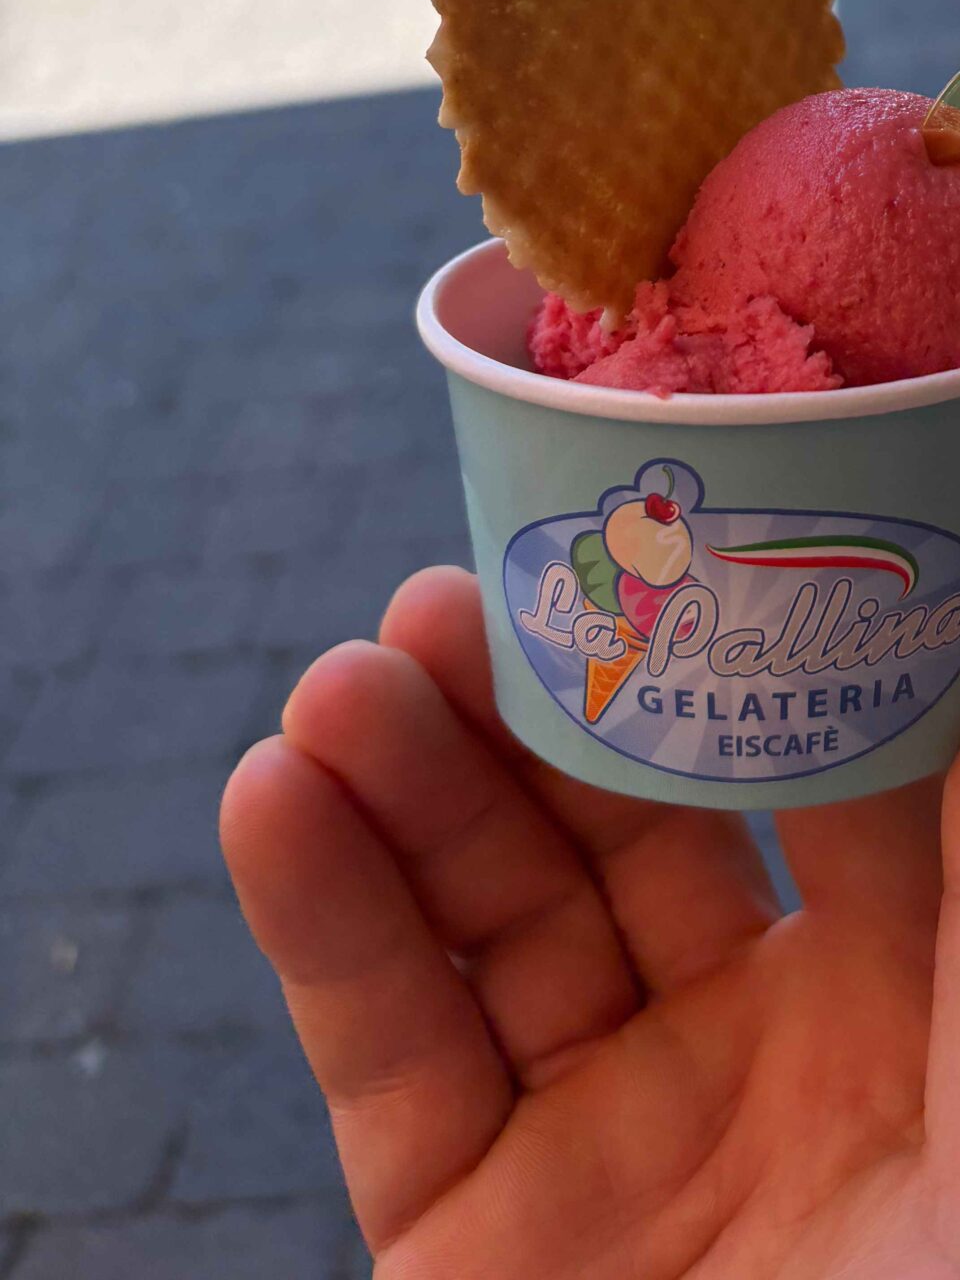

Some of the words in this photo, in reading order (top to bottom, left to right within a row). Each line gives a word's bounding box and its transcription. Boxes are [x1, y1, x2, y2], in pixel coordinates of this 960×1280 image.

[519, 560, 627, 662] La
[636, 673, 915, 721] GELATERIA
[717, 725, 840, 757] EISCAFÈ
